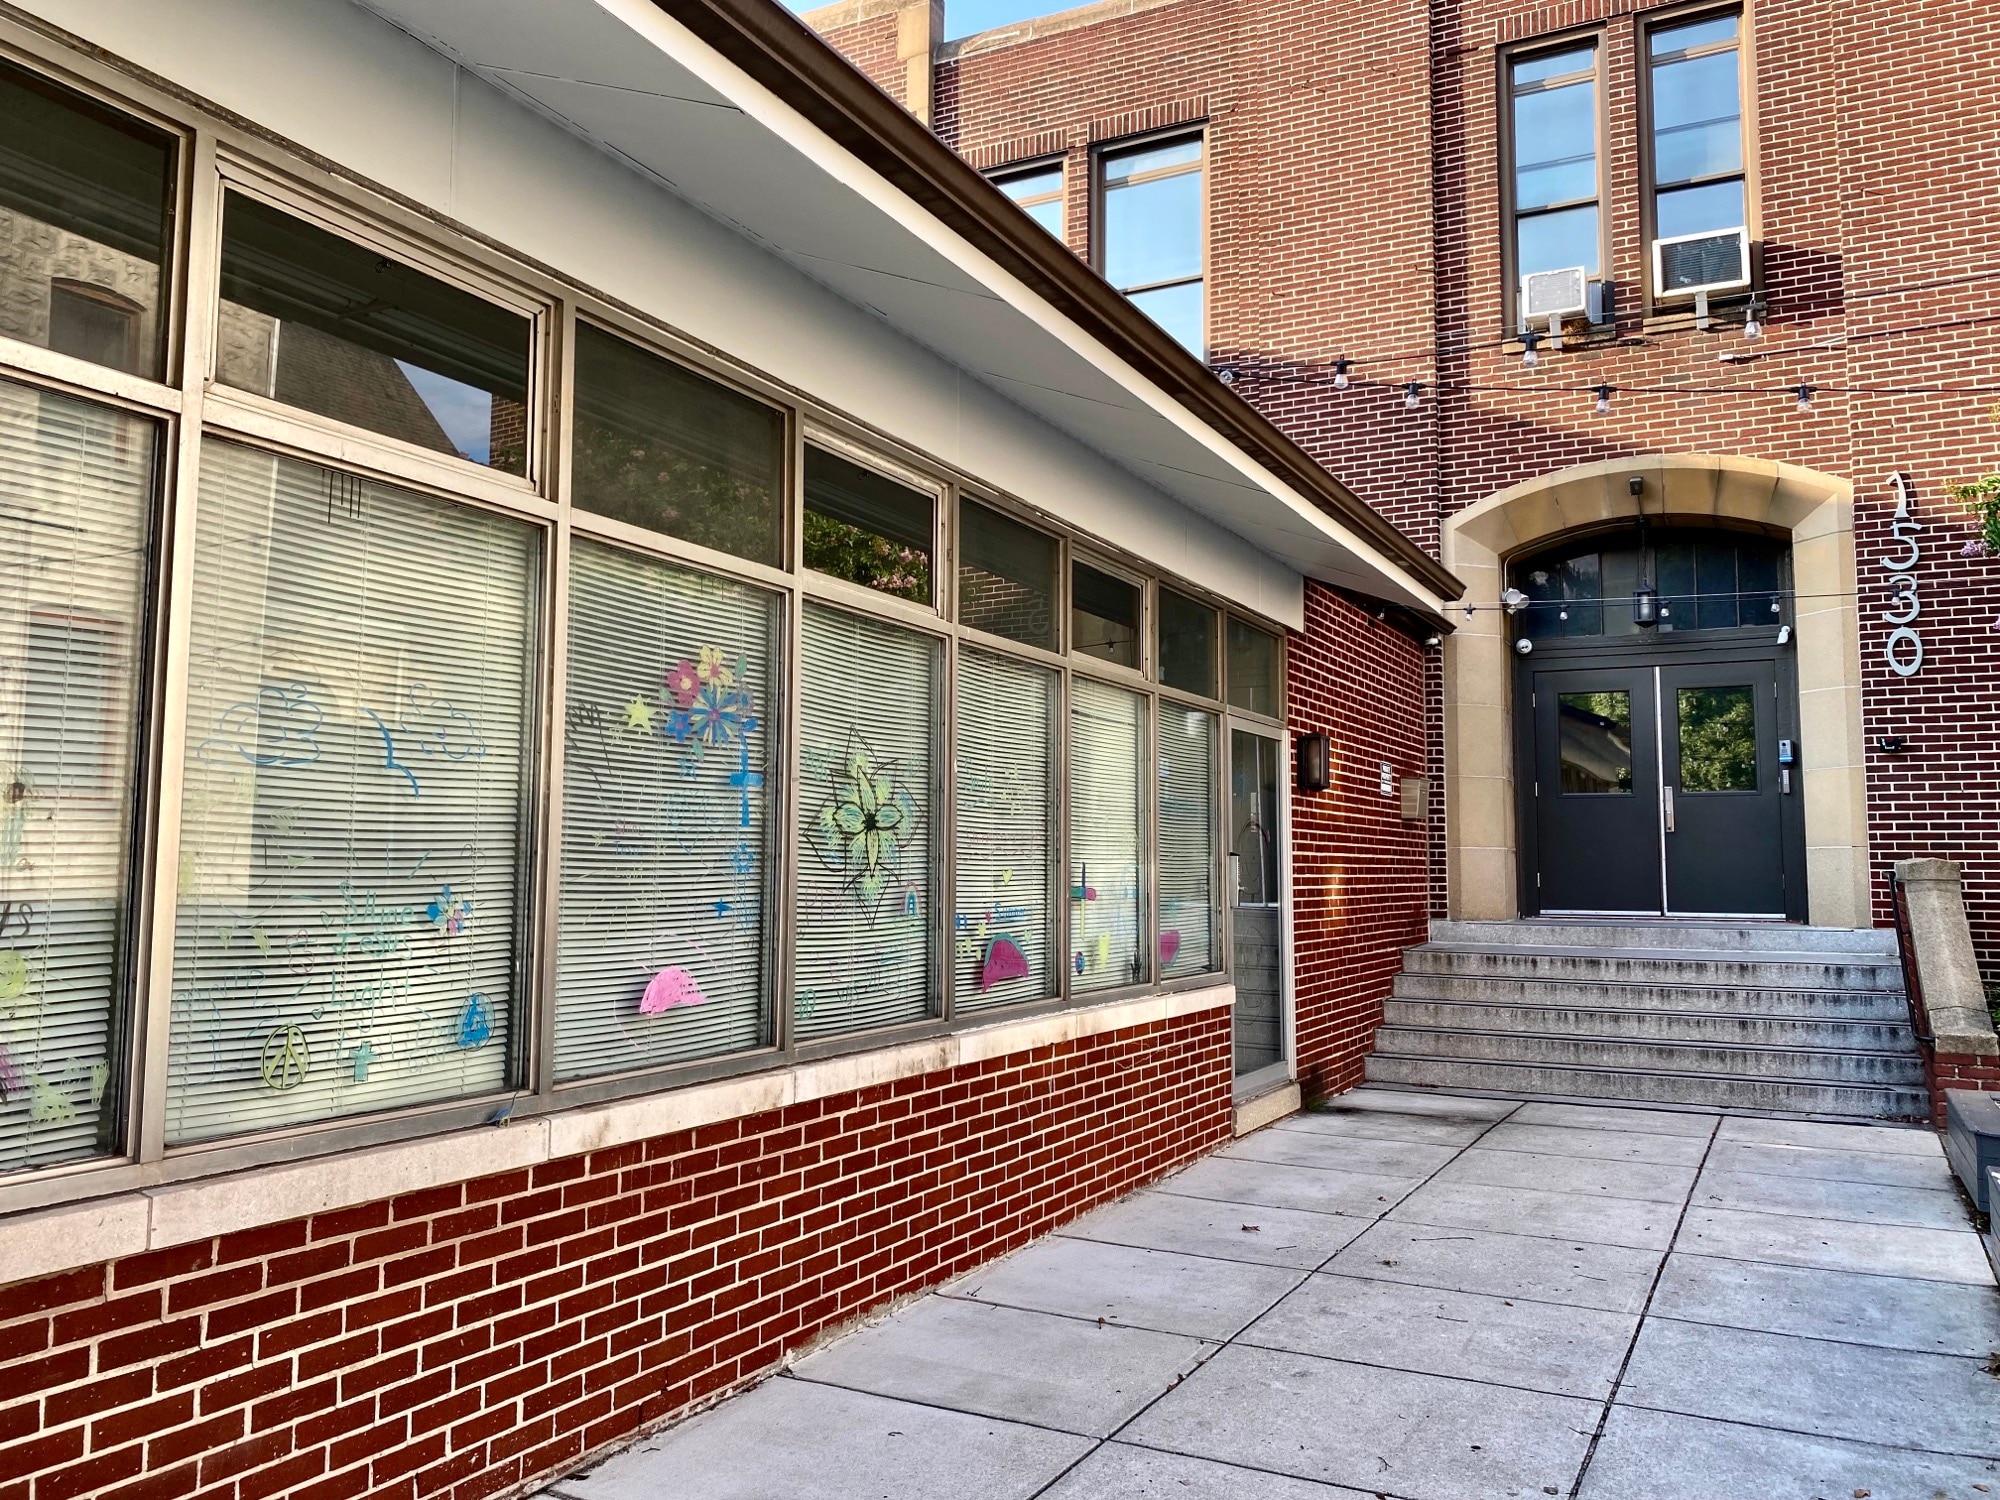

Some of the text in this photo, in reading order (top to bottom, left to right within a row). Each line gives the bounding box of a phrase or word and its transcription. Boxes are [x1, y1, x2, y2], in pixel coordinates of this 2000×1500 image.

[1882, 470, 1923, 677] 1530
[332, 930, 415, 961] Jesus
[330, 964, 413, 1034] Light
